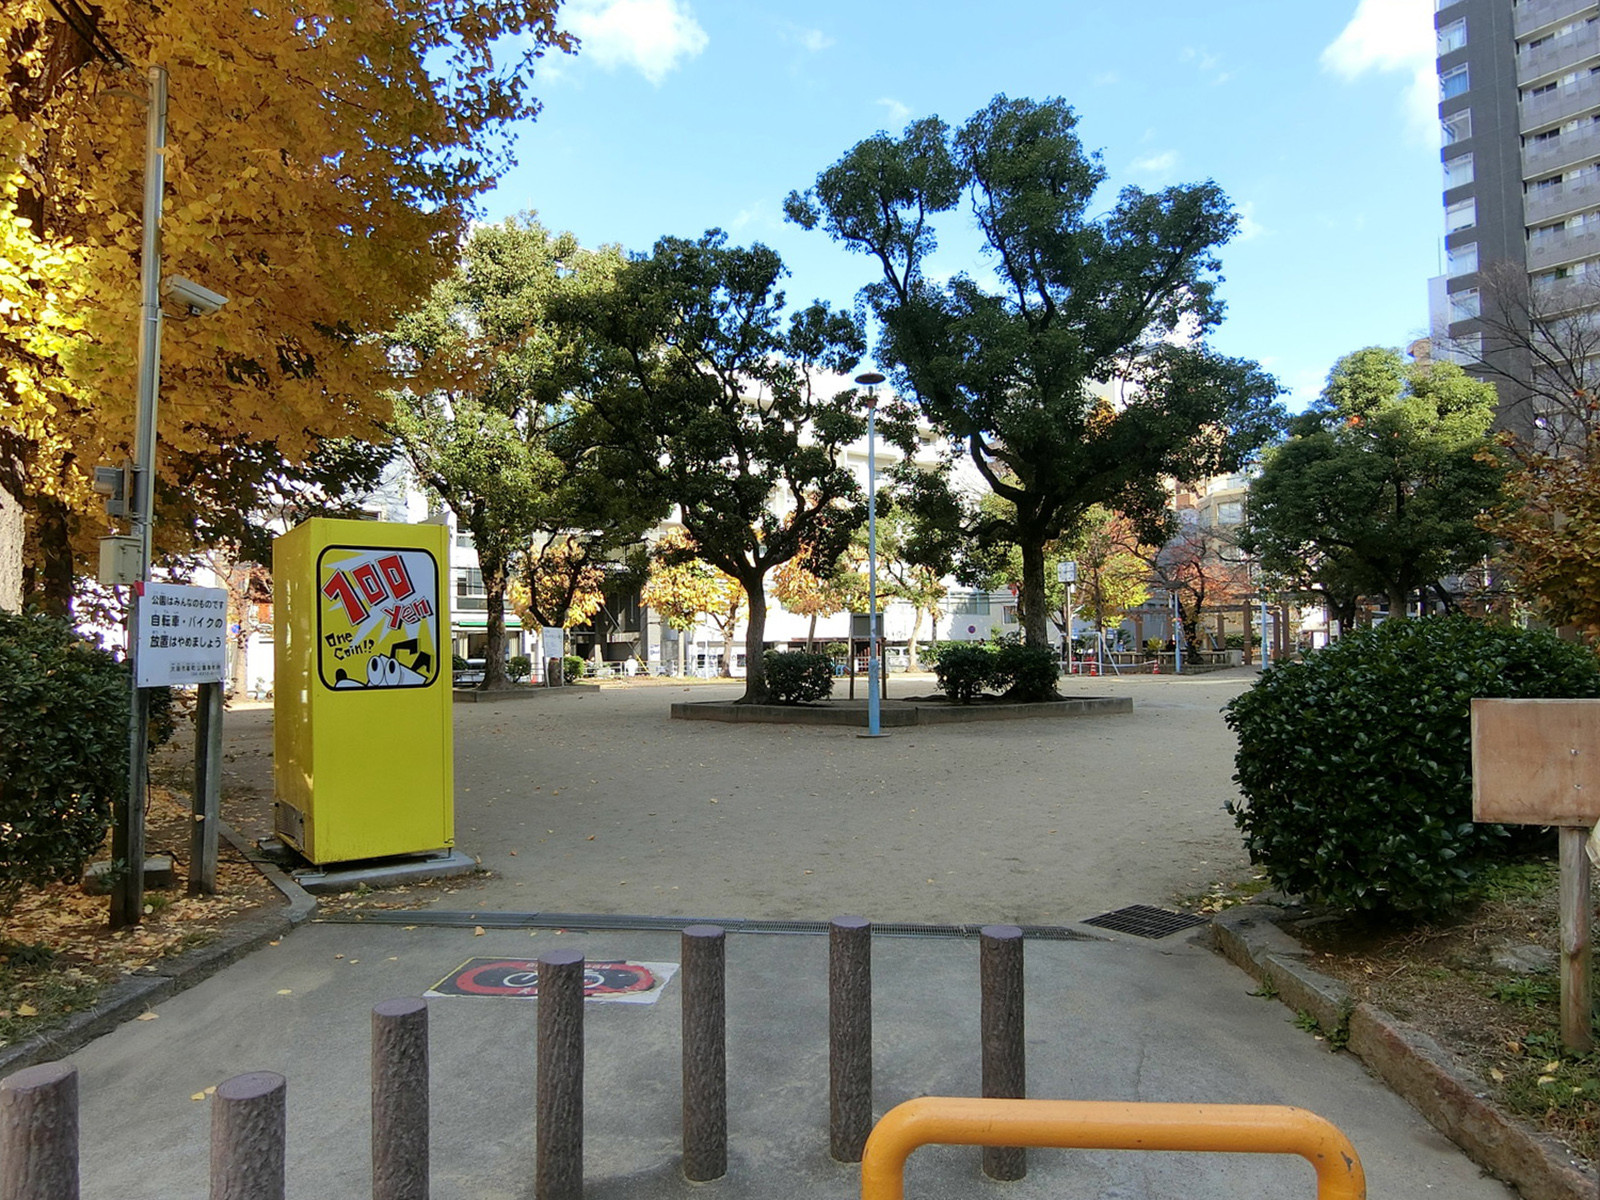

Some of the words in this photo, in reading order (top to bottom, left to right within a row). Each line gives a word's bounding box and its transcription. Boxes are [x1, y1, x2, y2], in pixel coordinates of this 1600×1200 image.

[321, 553, 415, 626] 100
[151, 595, 224, 609] 公園はみんなのものです
[151, 614, 223, 629] 自転車・バイクの
[150, 634, 222, 649] 放置はやめましょう
[325, 632, 353, 648] One
